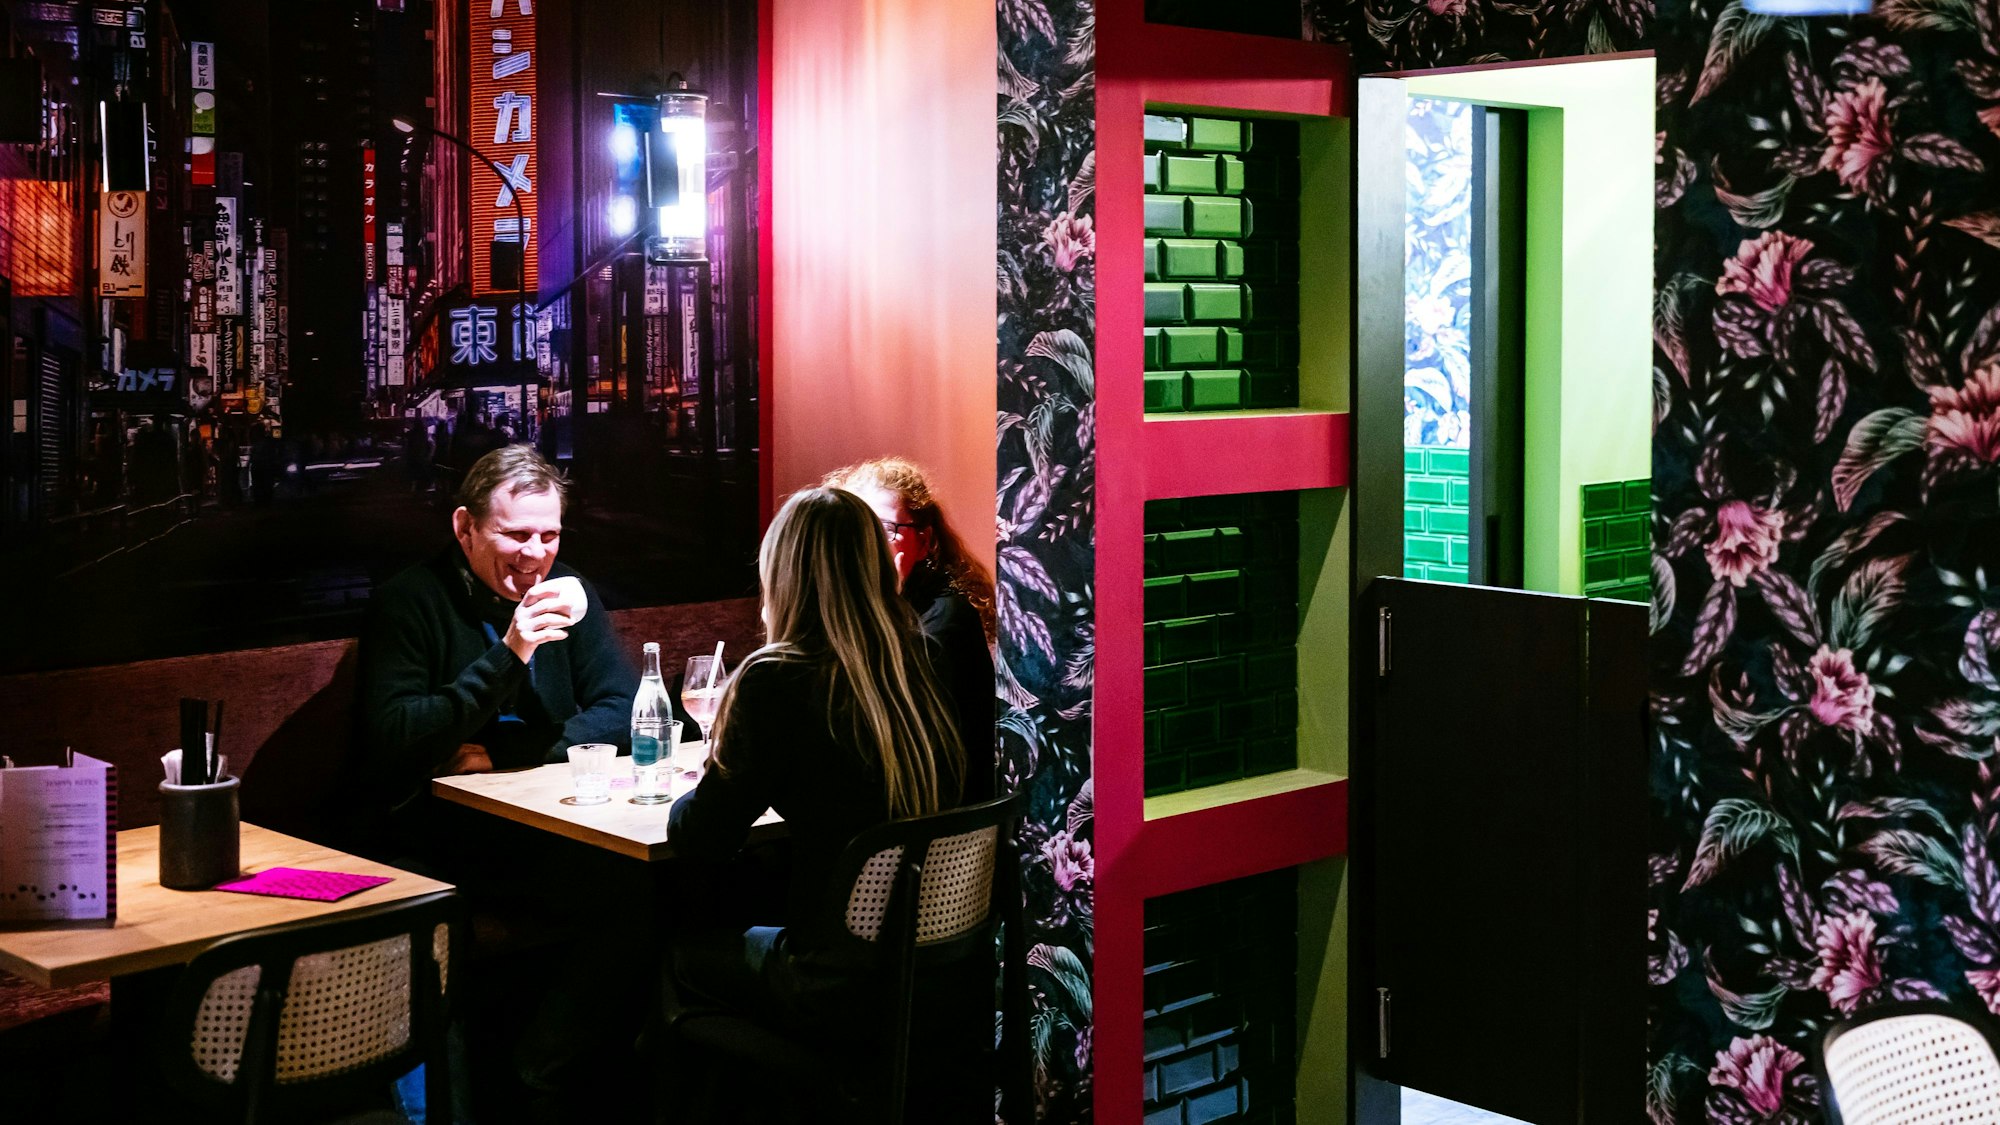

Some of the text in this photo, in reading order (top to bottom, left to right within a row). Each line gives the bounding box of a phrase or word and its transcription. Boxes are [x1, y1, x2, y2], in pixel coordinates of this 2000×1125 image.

[364, 163, 375, 224] カラオケ
[116, 367, 177, 392] カメラ
